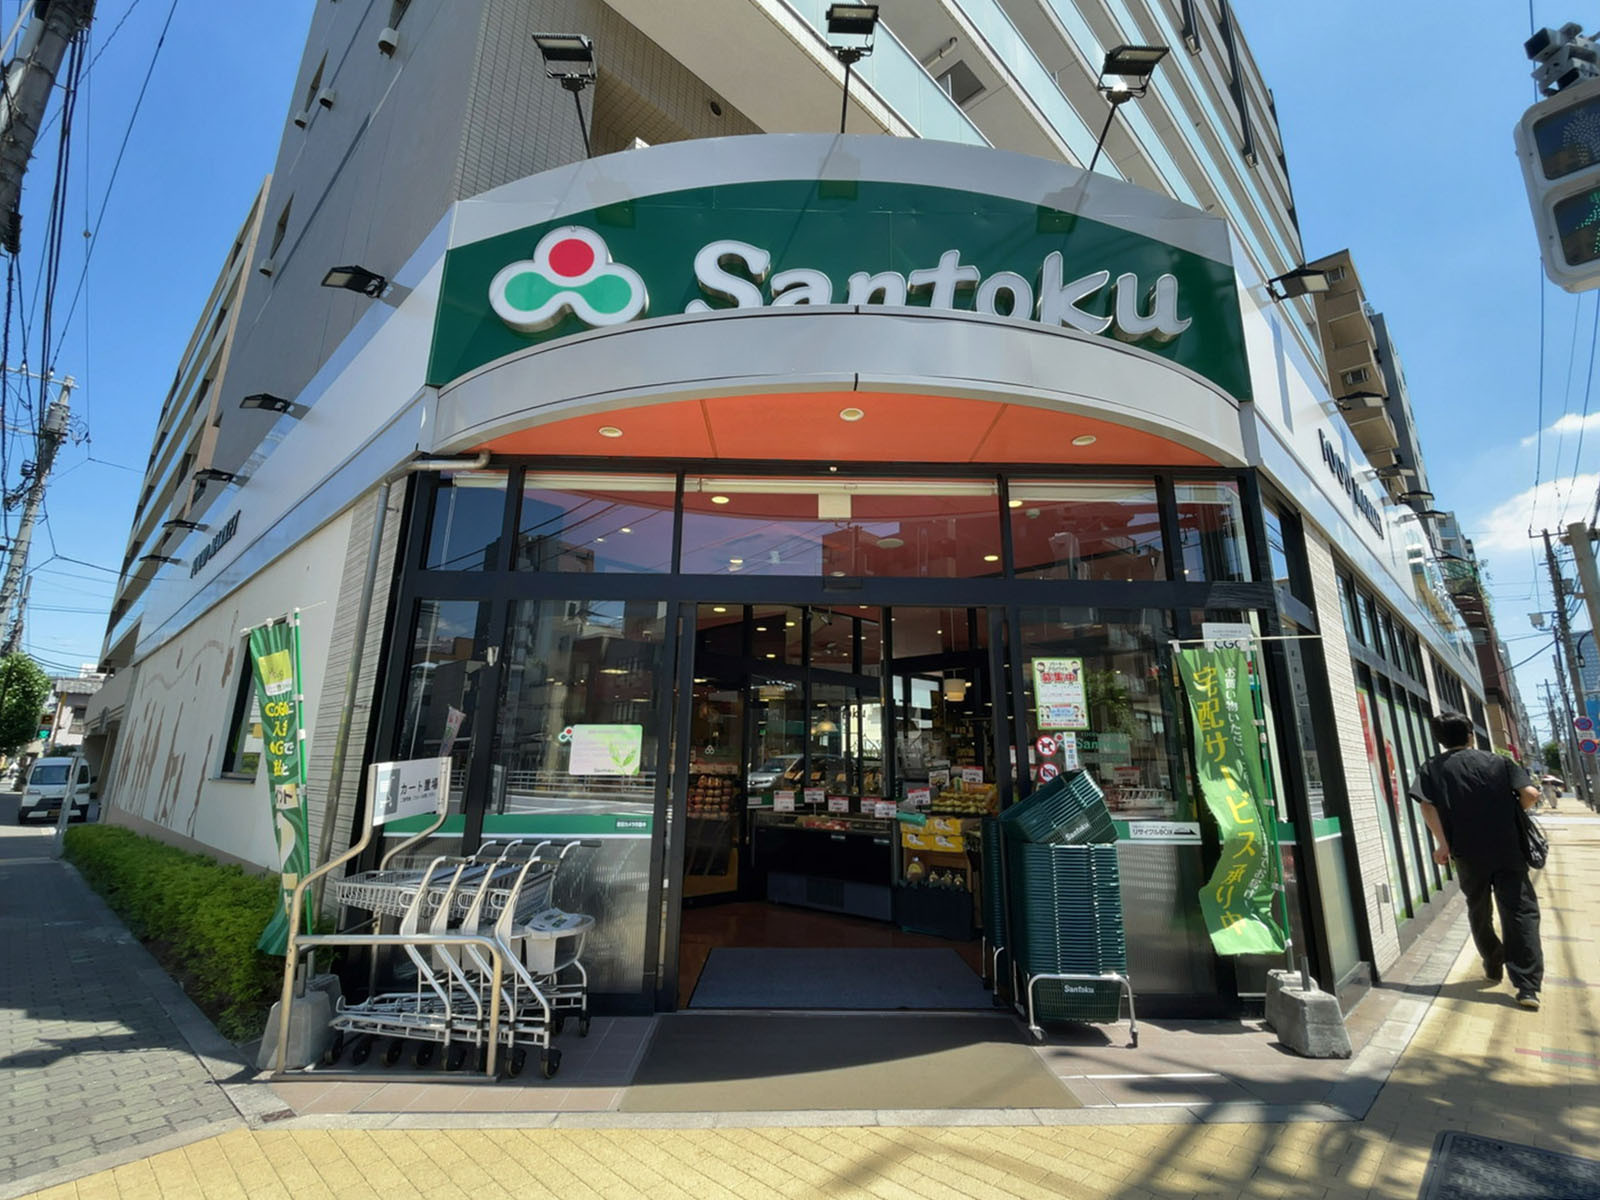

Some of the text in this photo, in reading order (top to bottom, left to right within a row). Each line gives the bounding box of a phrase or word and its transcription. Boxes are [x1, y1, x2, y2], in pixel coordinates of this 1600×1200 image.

[684, 239, 1193, 342] Santoku
[400, 778, 439, 795] カート置場
[1193, 663, 1256, 936] 宅配サービス承り中
[1063, 984, 1095, 994] Santoku
